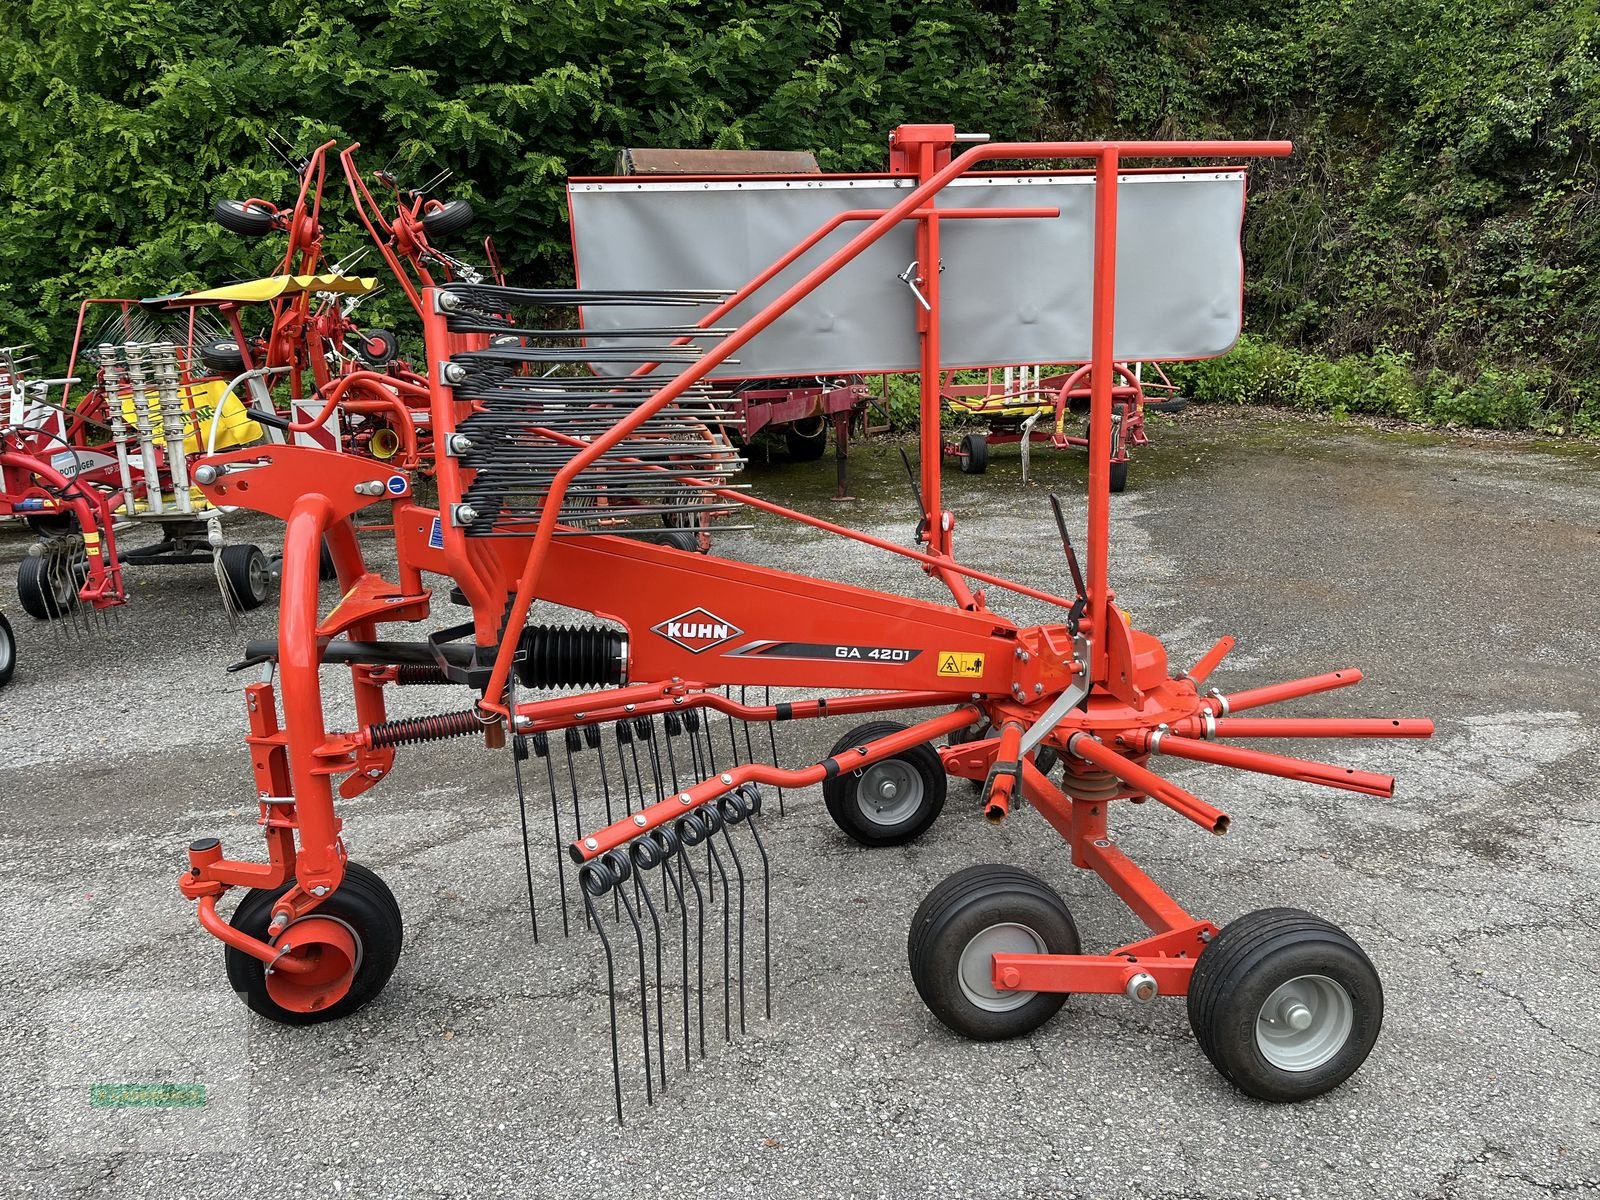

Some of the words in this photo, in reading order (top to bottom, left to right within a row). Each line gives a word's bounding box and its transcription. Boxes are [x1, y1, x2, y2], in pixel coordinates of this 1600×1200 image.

[667, 622, 728, 639] KUHN
[835, 646, 862, 659] GA
[867, 648, 910, 661] 4201
